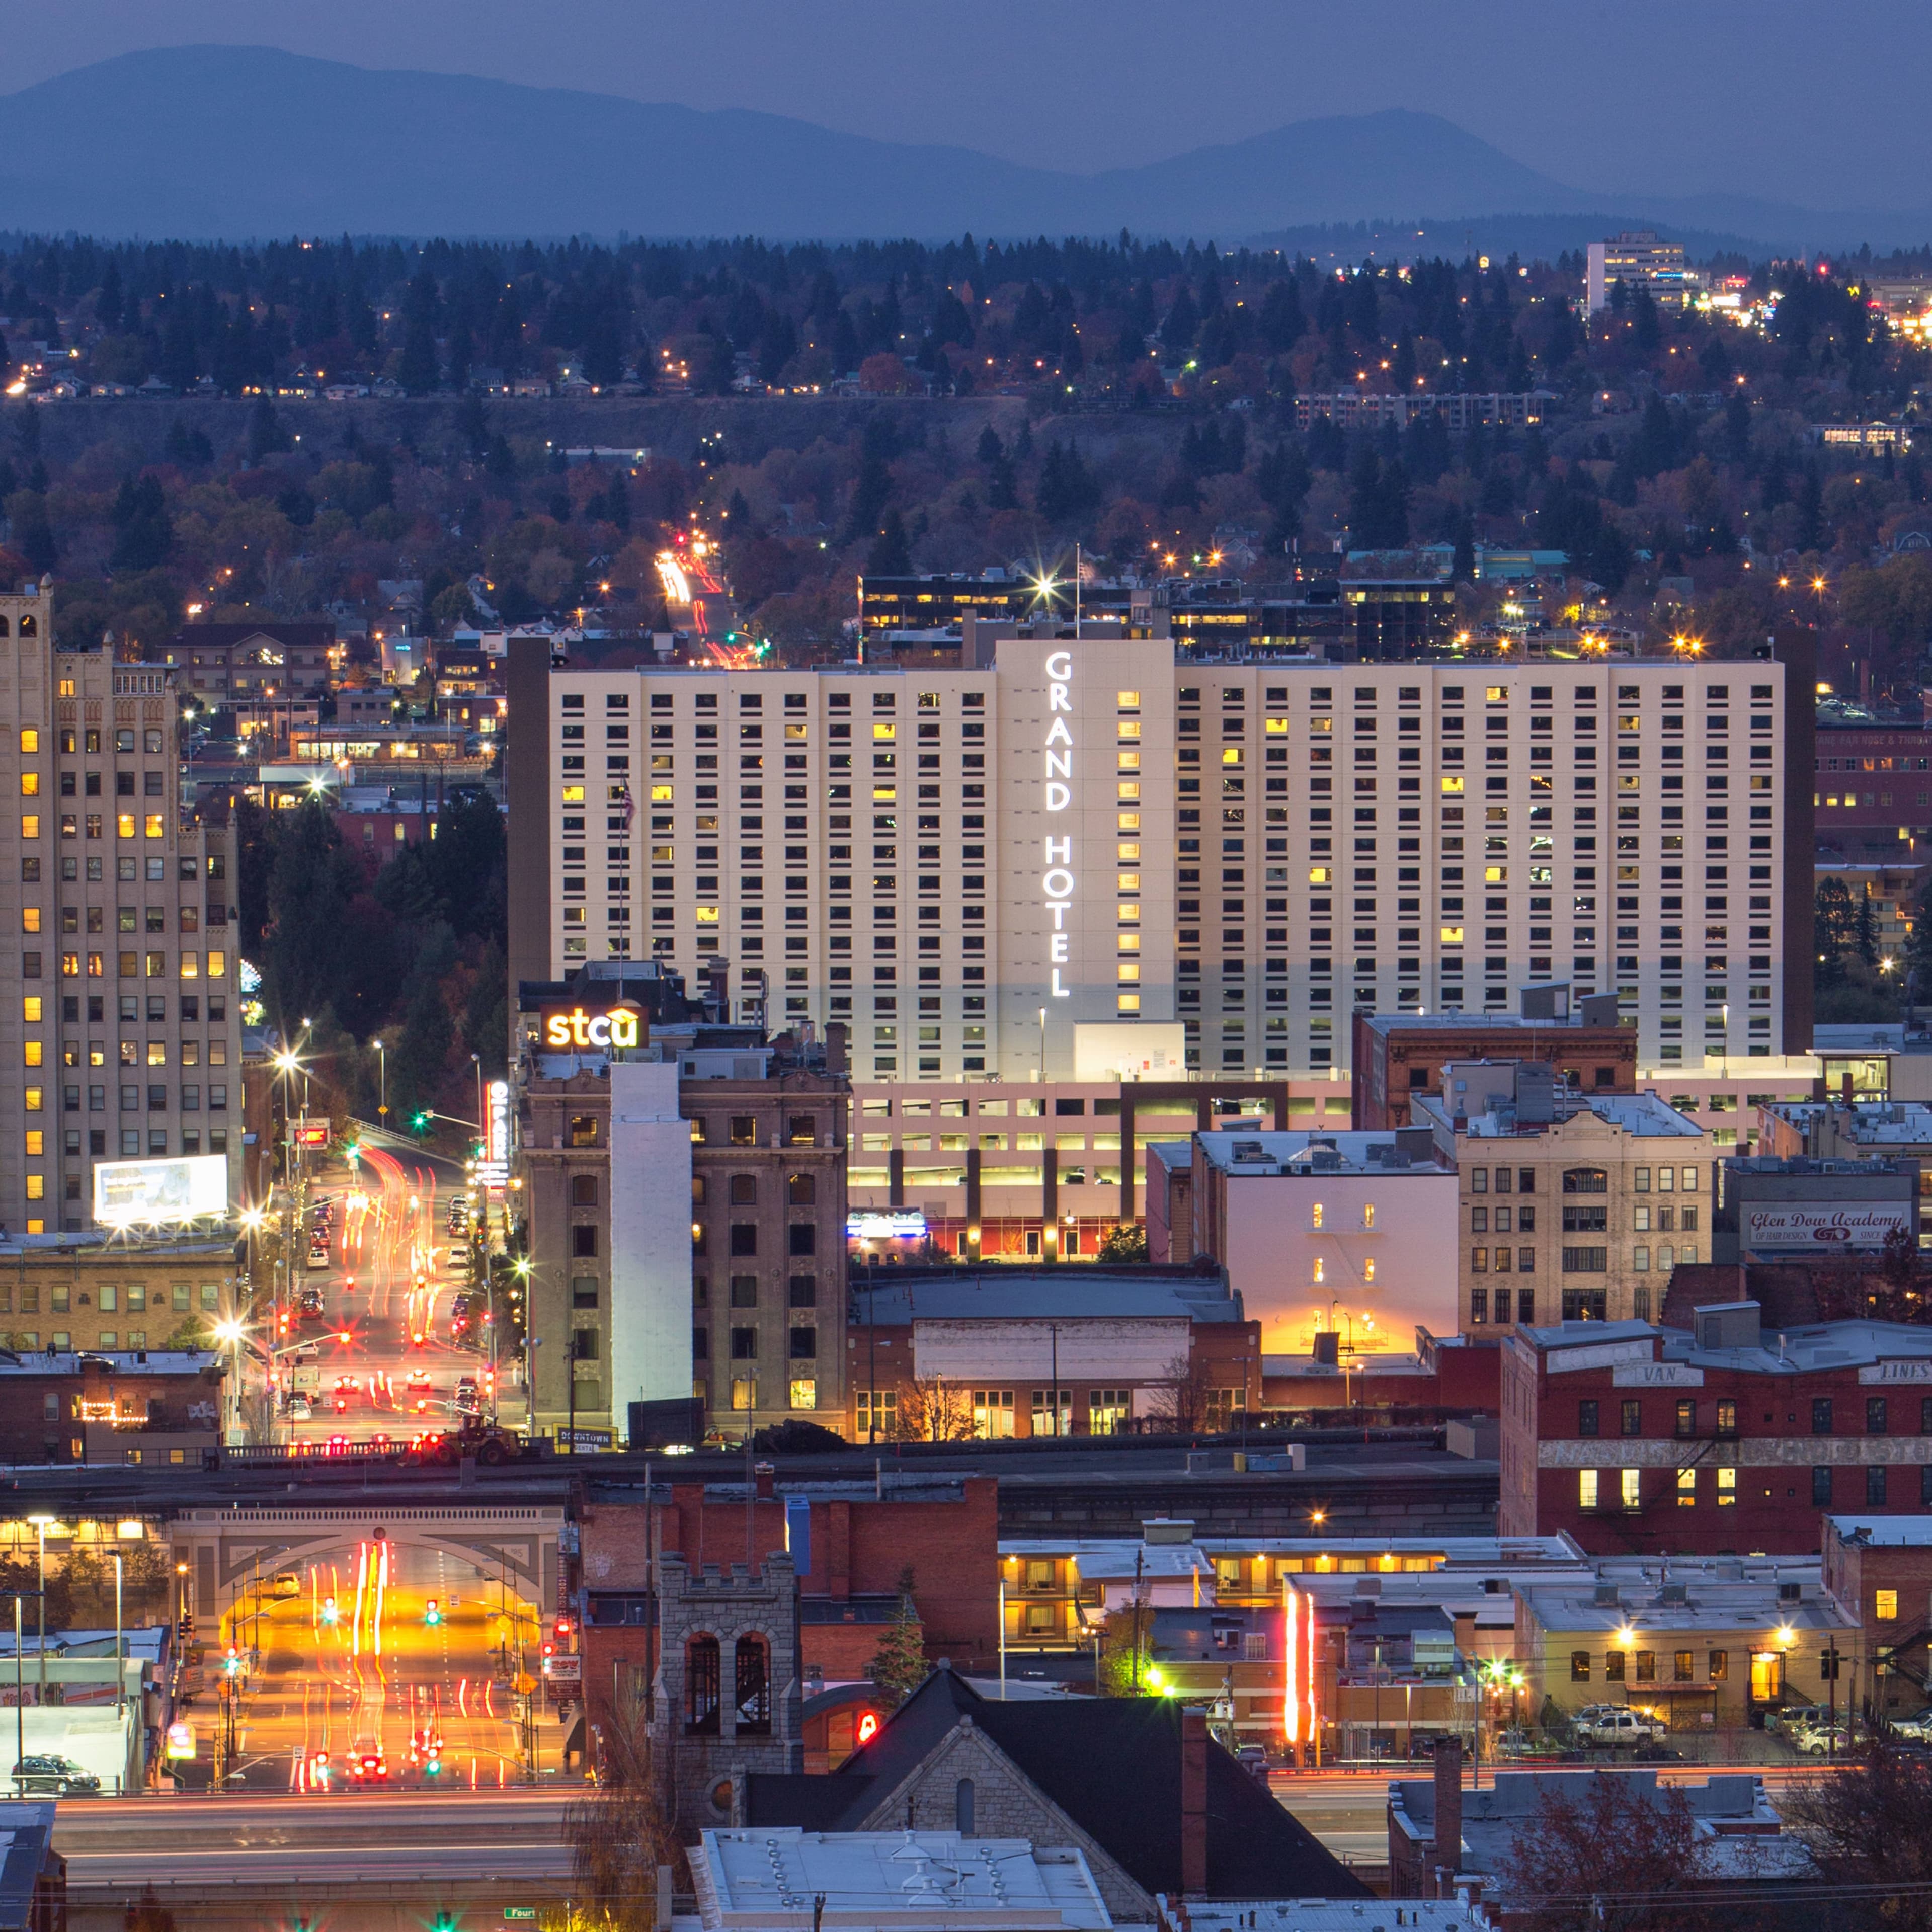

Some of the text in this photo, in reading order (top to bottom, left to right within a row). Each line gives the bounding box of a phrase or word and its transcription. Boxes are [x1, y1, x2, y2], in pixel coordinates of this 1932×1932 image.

[1839, 736, 1858, 745] EAR
[1862, 736, 1884, 745] NOSE
[1888, 736, 1894, 745] &
[1043, 652, 1074, 996] GRAND HOTEL
[548, 1008, 638, 1046] stcu
[1751, 1212, 1903, 1231] Glen Dow Academy
[1860, 1231, 1881, 1239] SINCE
[1643, 1364, 1930, 1381] VAN LINES
[512, 1909, 542, 1917] Fourt
